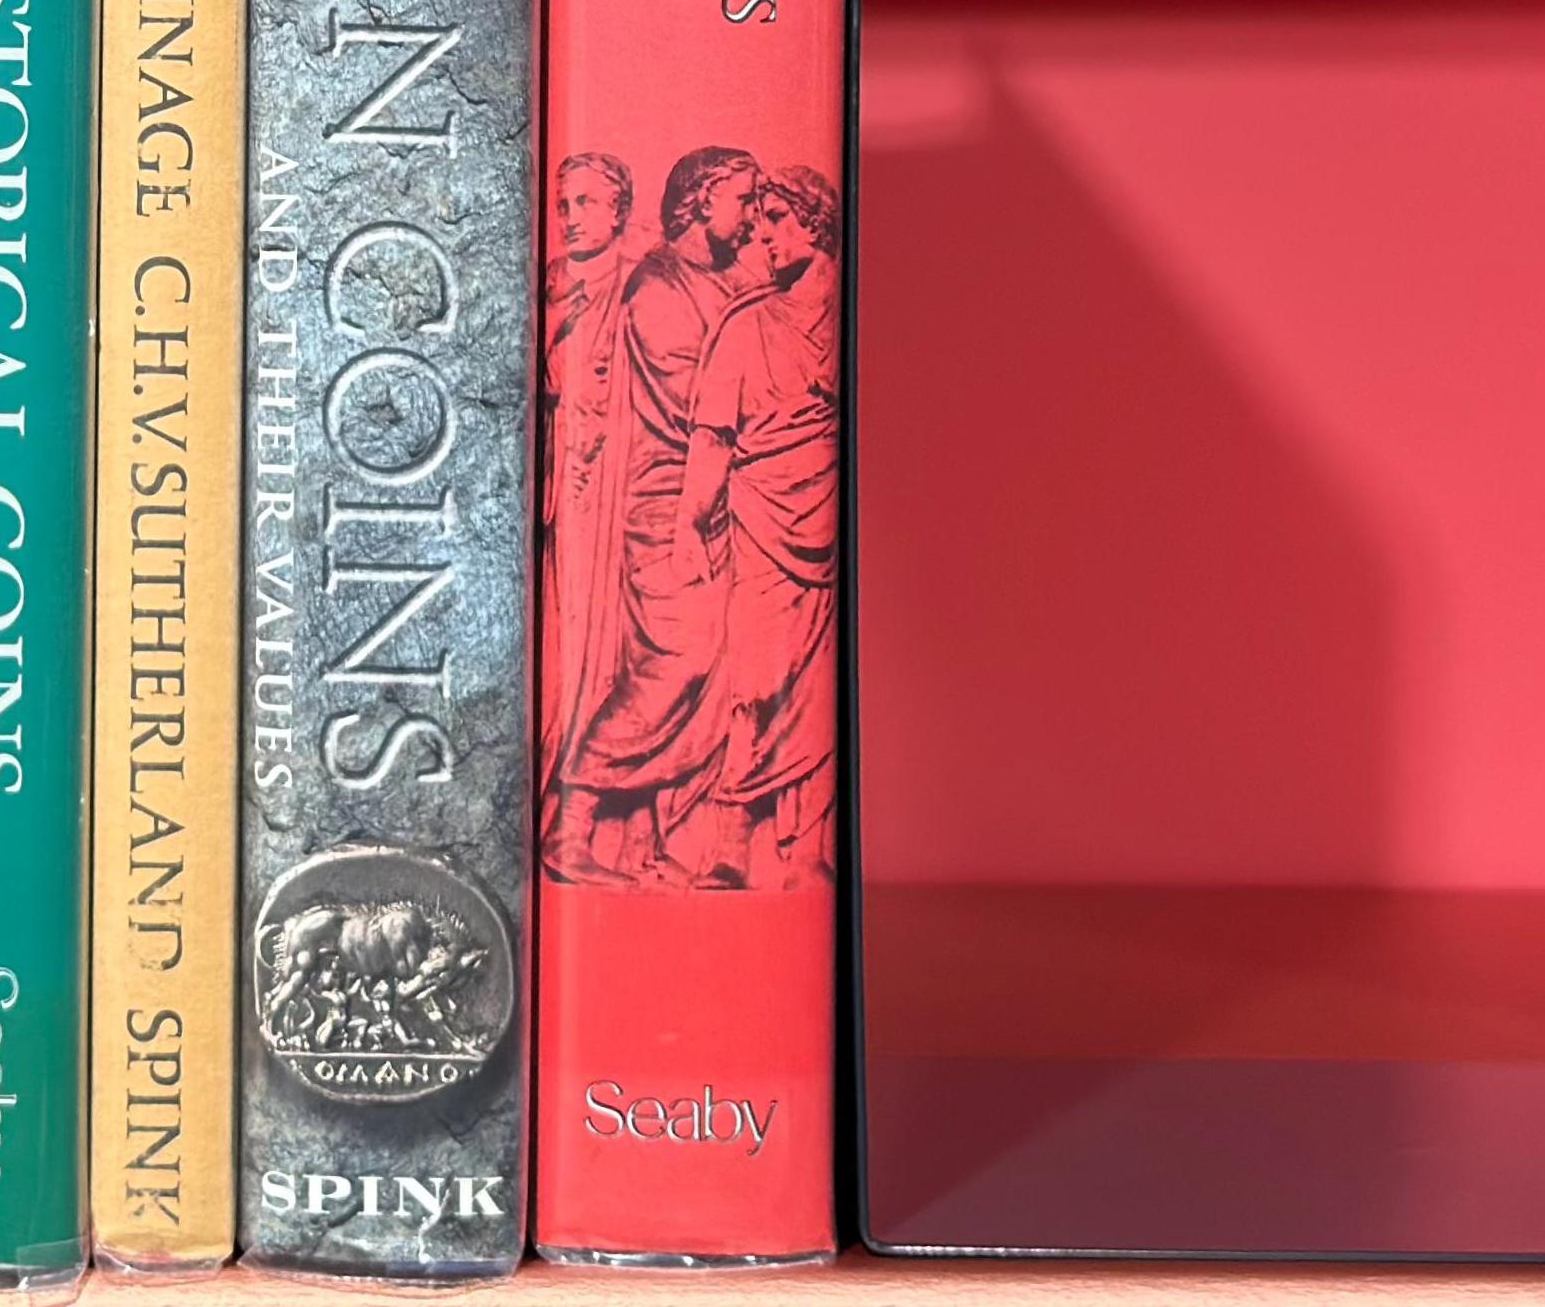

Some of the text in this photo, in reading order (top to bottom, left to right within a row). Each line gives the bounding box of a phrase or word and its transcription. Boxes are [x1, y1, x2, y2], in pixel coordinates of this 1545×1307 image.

[254, 146, 300, 791] AND THEIR VALUES
[321, 220, 458, 789] COINS
[124, 1009, 184, 1228] SPINK
[260, 1171, 507, 1217] SPINK
[583, 1079, 778, 1156] Seaby
